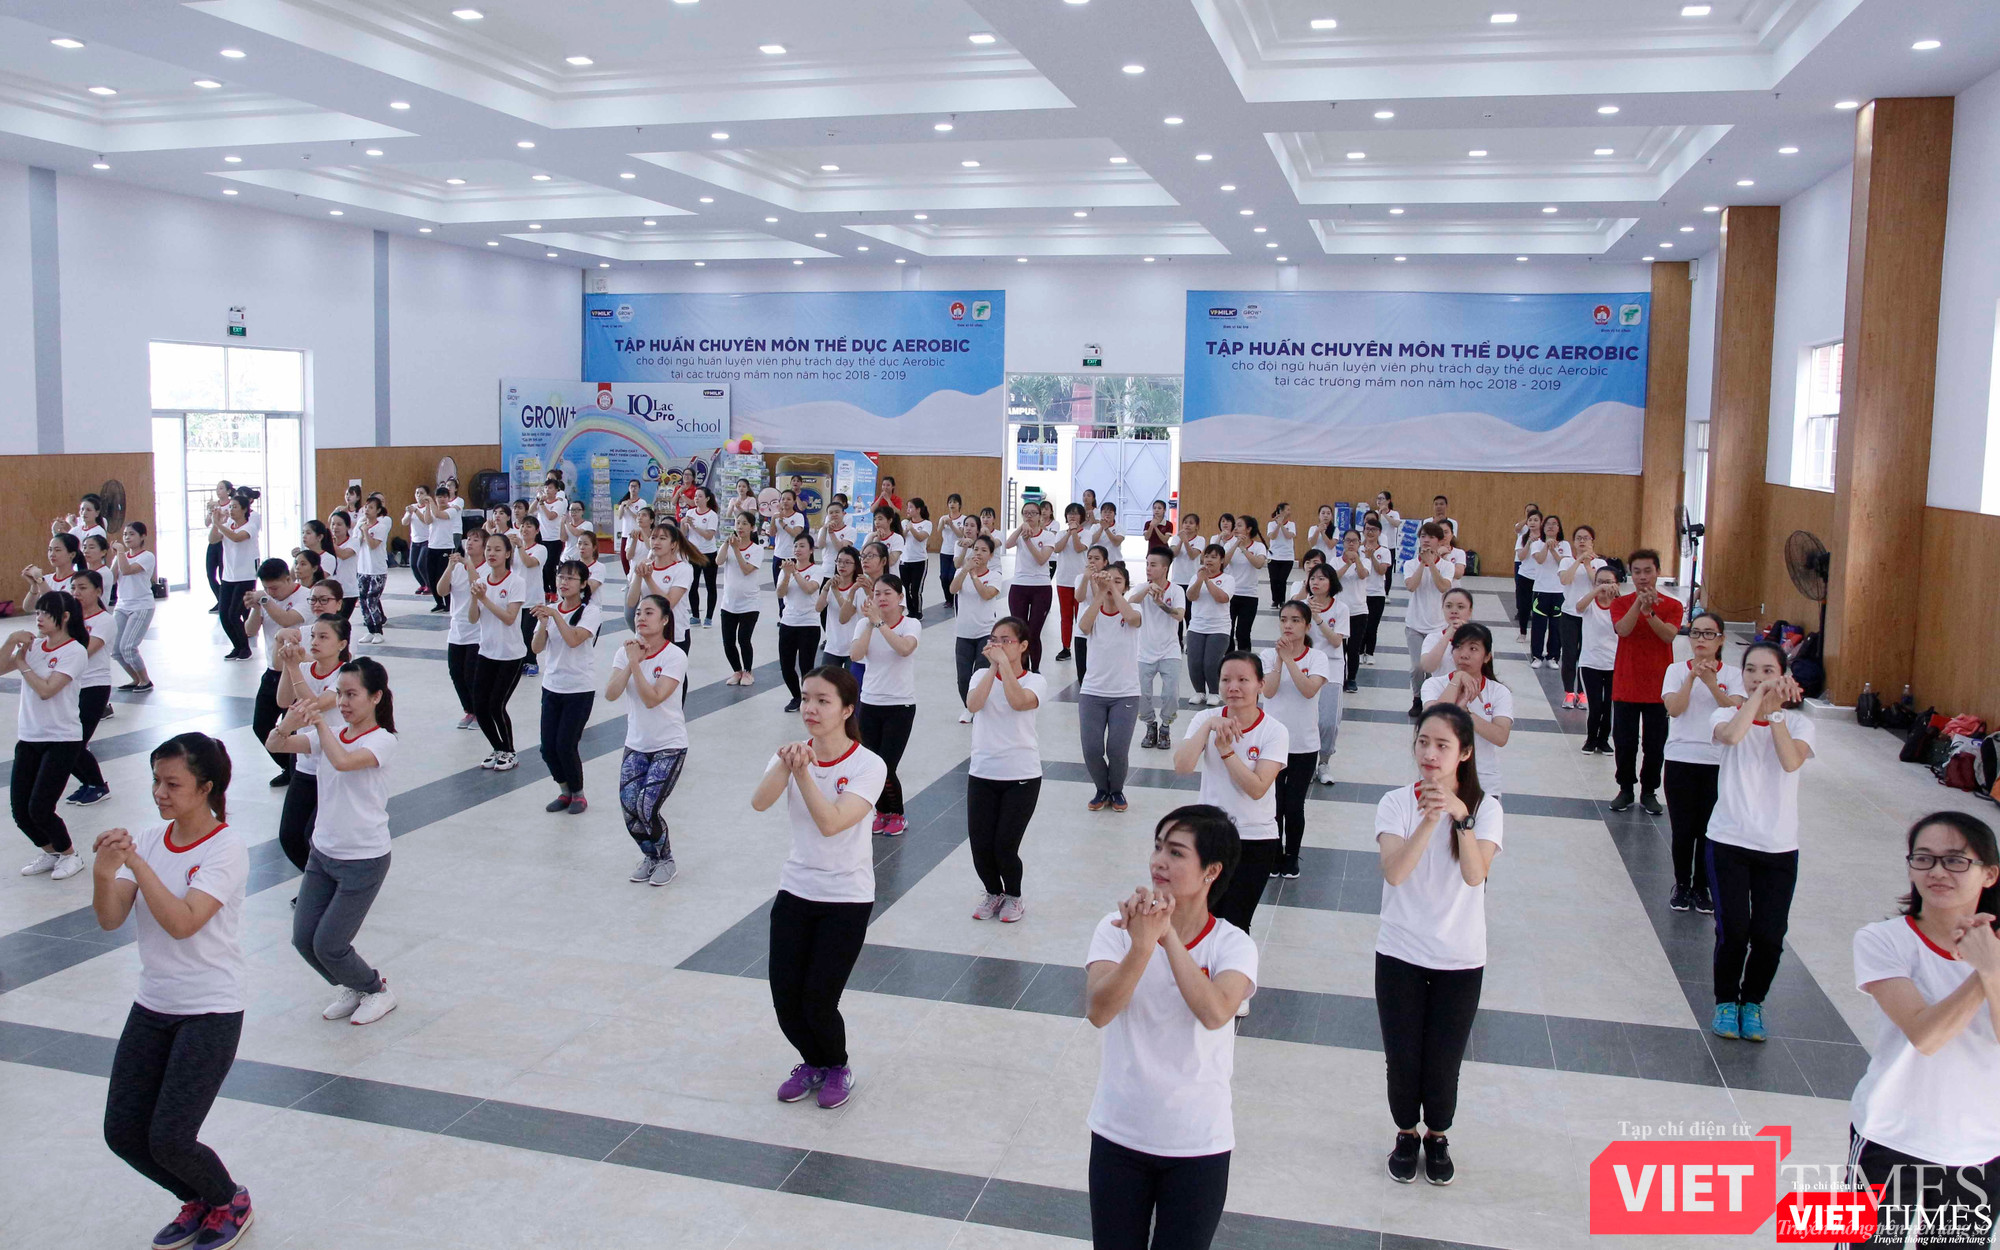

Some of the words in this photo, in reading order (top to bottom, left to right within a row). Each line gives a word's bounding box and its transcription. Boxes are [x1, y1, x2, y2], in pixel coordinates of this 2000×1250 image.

[615, 337, 646, 354] TẬP
[650, 336, 694, 352] HUẤN
[700, 337, 766, 352] CHUYÊN
[772, 337, 809, 352] MÔN
[814, 336, 847, 352] THỂ
[852, 339, 887, 354] DỤC
[892, 339, 970, 352] AEROBIC
[1206, 339, 1244, 357] TẬP
[1250, 339, 1304, 356] HUẤN
[1311, 340, 1392, 356] CHUYÊN
[1399, 341, 1444, 357] MÔN
[1451, 340, 1490, 358] THỂ
[1496, 345, 1539, 361] DỤC
[1545, 345, 1639, 360] AEROBIC
[636, 357, 654, 365] cho
[657, 356, 672, 366] đội
[676, 356, 694, 366] ngũ
[698, 356, 721, 365] huấn
[726, 356, 752, 366] luyện
[756, 357, 778, 366] viên
[782, 357, 800, 367] phụ
[805, 357, 831, 366] trách
[836, 357, 854, 367] dạy
[878, 357, 899, 368] dục
[903, 357, 945, 366] Aerobic
[1232, 360, 1254, 370] cho
[1258, 360, 1277, 372] đội
[1282, 361, 1304, 372] ngũ
[1309, 361, 1338, 371] huấn
[1343, 362, 1376, 373] luyện
[1381, 362, 1406, 372] viên
[1411, 363, 1434, 374] phụ
[1439, 363, 1471, 373] trách
[1476, 364, 1499, 376] dạy
[1529, 365, 1552, 376] dục
[1557, 365, 1608, 376] Aerobic
[671, 370, 683, 380] tại
[686, 370, 704, 378] các
[706, 370, 740, 380] trường
[774, 371, 792, 379] non
[797, 370, 818, 379] năm
[823, 370, 841, 380] học
[845, 370, 870, 380] 2018
[881, 370, 906, 380] 2019
[1275, 376, 1290, 386] tại
[1294, 376, 1314, 386] các
[1319, 376, 1360, 388] trường
[1400, 379, 1423, 388] non
[1428, 378, 1455, 388] năm
[1460, 378, 1483, 390] học
[1488, 379, 1517, 390] 2018
[1531, 380, 1561, 390] 2019
[627, 394, 657, 422] IQ
[654, 400, 673, 411] Lac
[522, 405, 576, 428] GROW+
[656, 412, 675, 420] Pro
[676, 418, 720, 432] School
